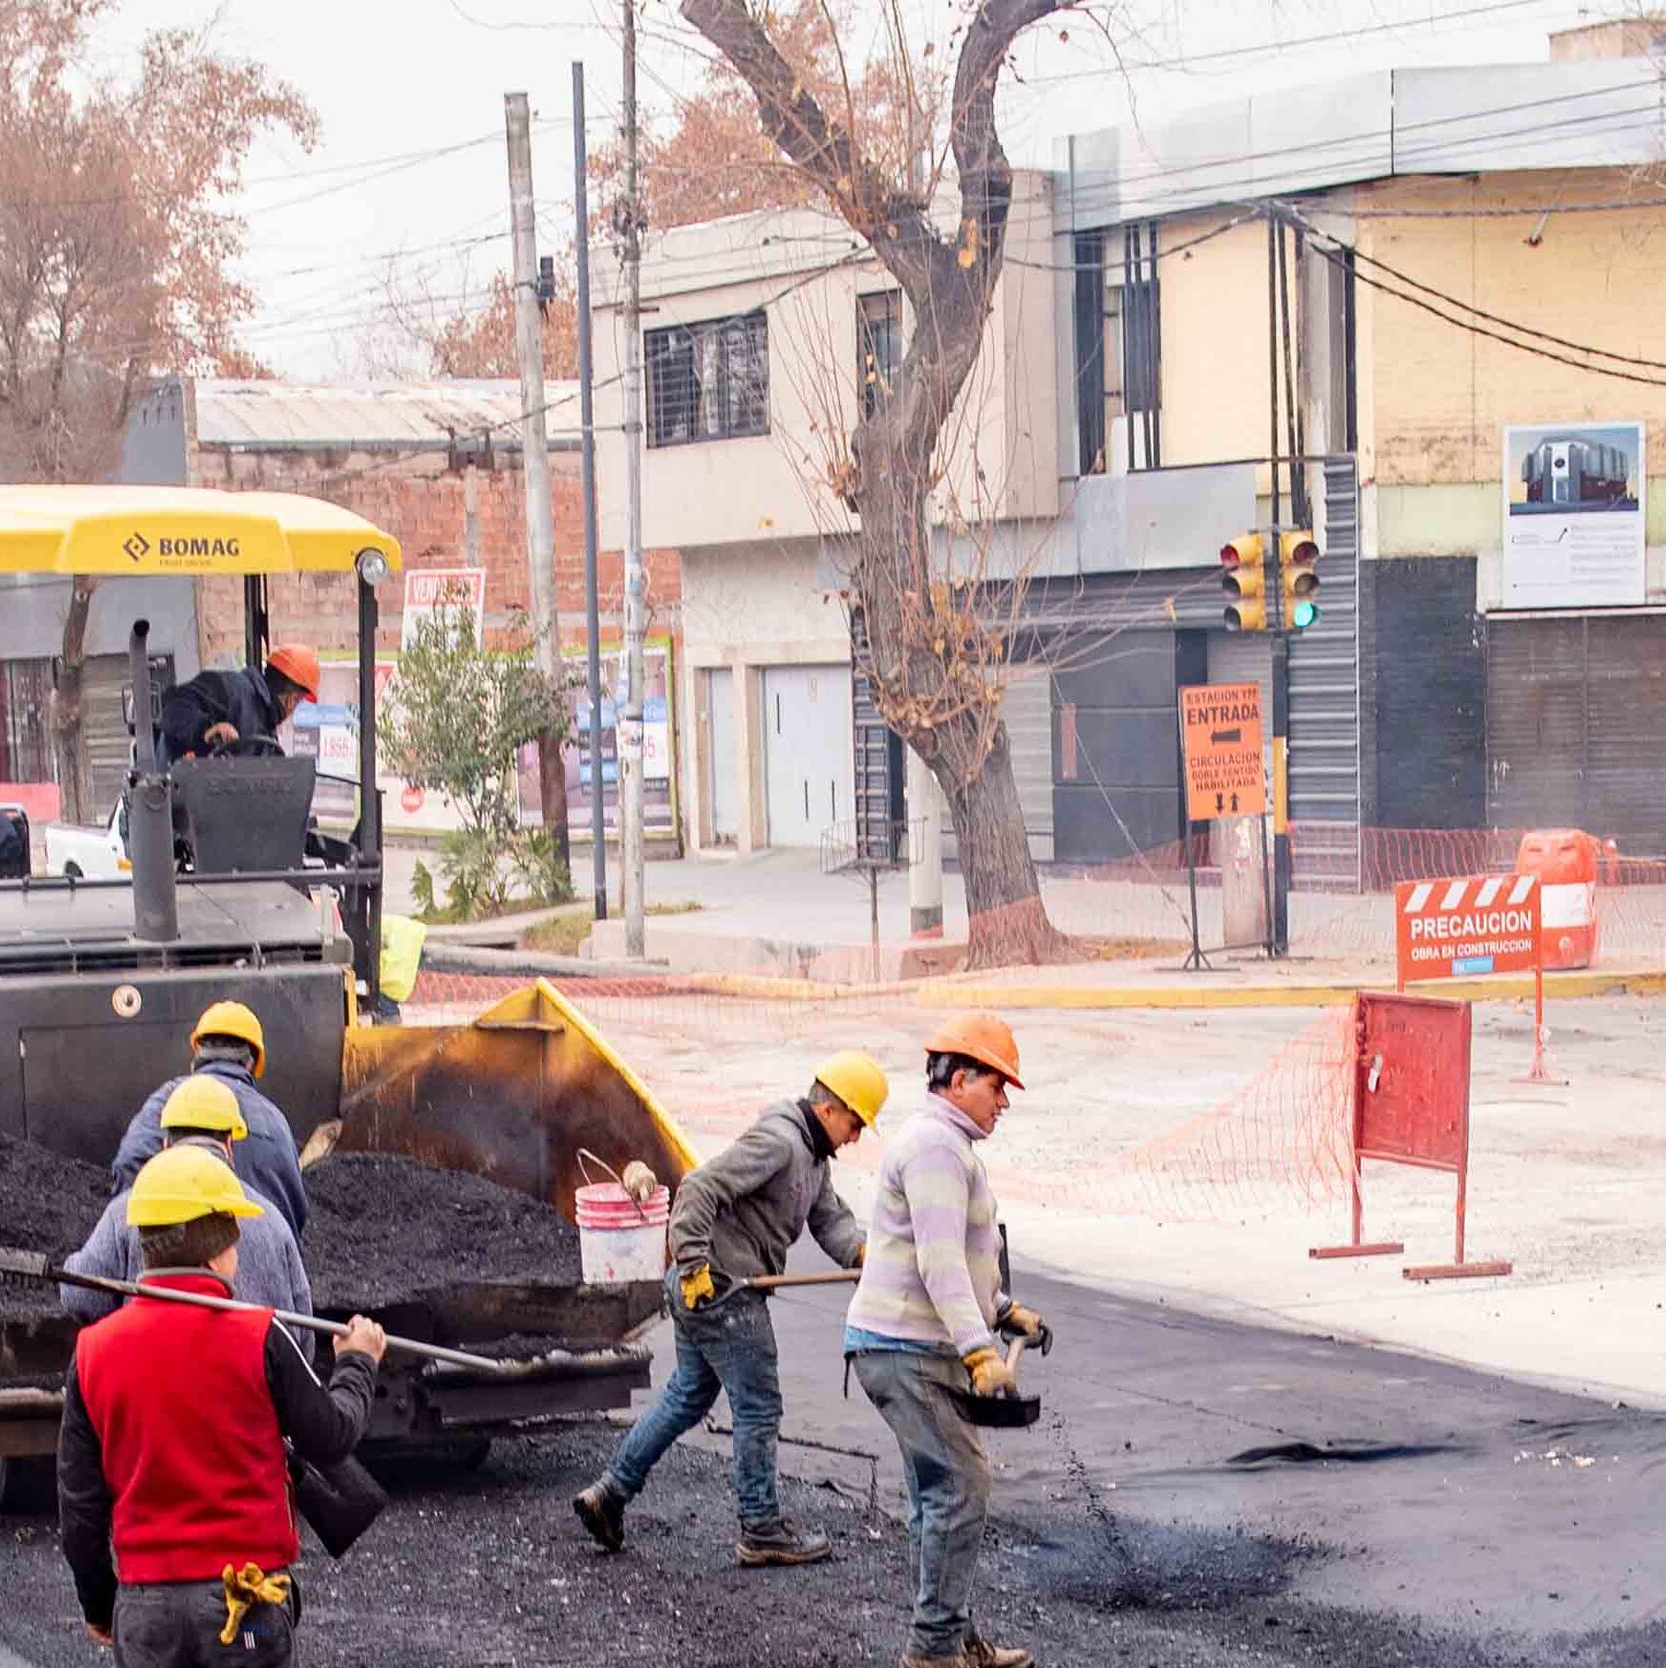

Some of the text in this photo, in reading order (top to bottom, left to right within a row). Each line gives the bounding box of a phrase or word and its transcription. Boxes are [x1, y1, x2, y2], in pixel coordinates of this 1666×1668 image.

[159, 537, 240, 557] BOMAG
[1186, 690, 1239, 704] ESTACION
[1187, 704, 1260, 725] ENTRADA
[1190, 752, 1261, 768] CIRCULACION
[1192, 765, 1260, 781] DOBLE SENTIDO
[1195, 777, 1257, 792] HABILITADA
[1410, 910, 1533, 940] PRECAUCION
[1411, 939, 1533, 961] OBRA EN CONSTRUCCION
